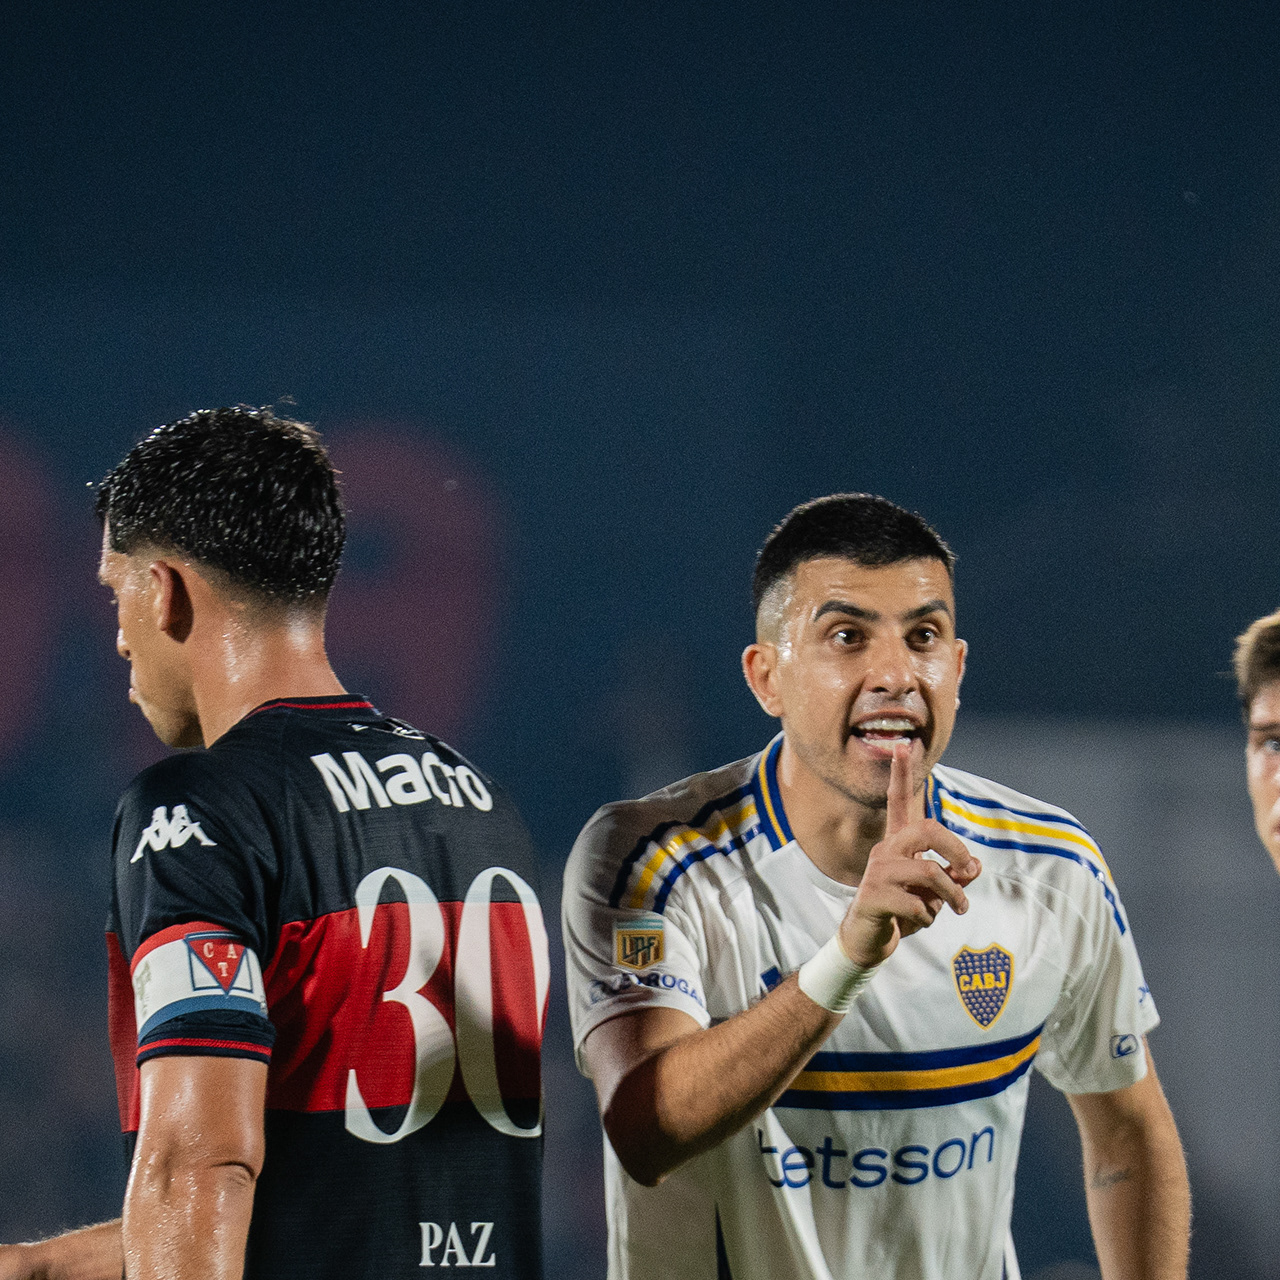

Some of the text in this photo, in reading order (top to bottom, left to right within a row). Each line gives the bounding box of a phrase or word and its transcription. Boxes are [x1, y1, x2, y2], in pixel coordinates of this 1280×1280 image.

[959, 971, 1006, 991] CABJ
[344, 866, 550, 1144] 30
[419, 1221, 496, 1267] PAZ
